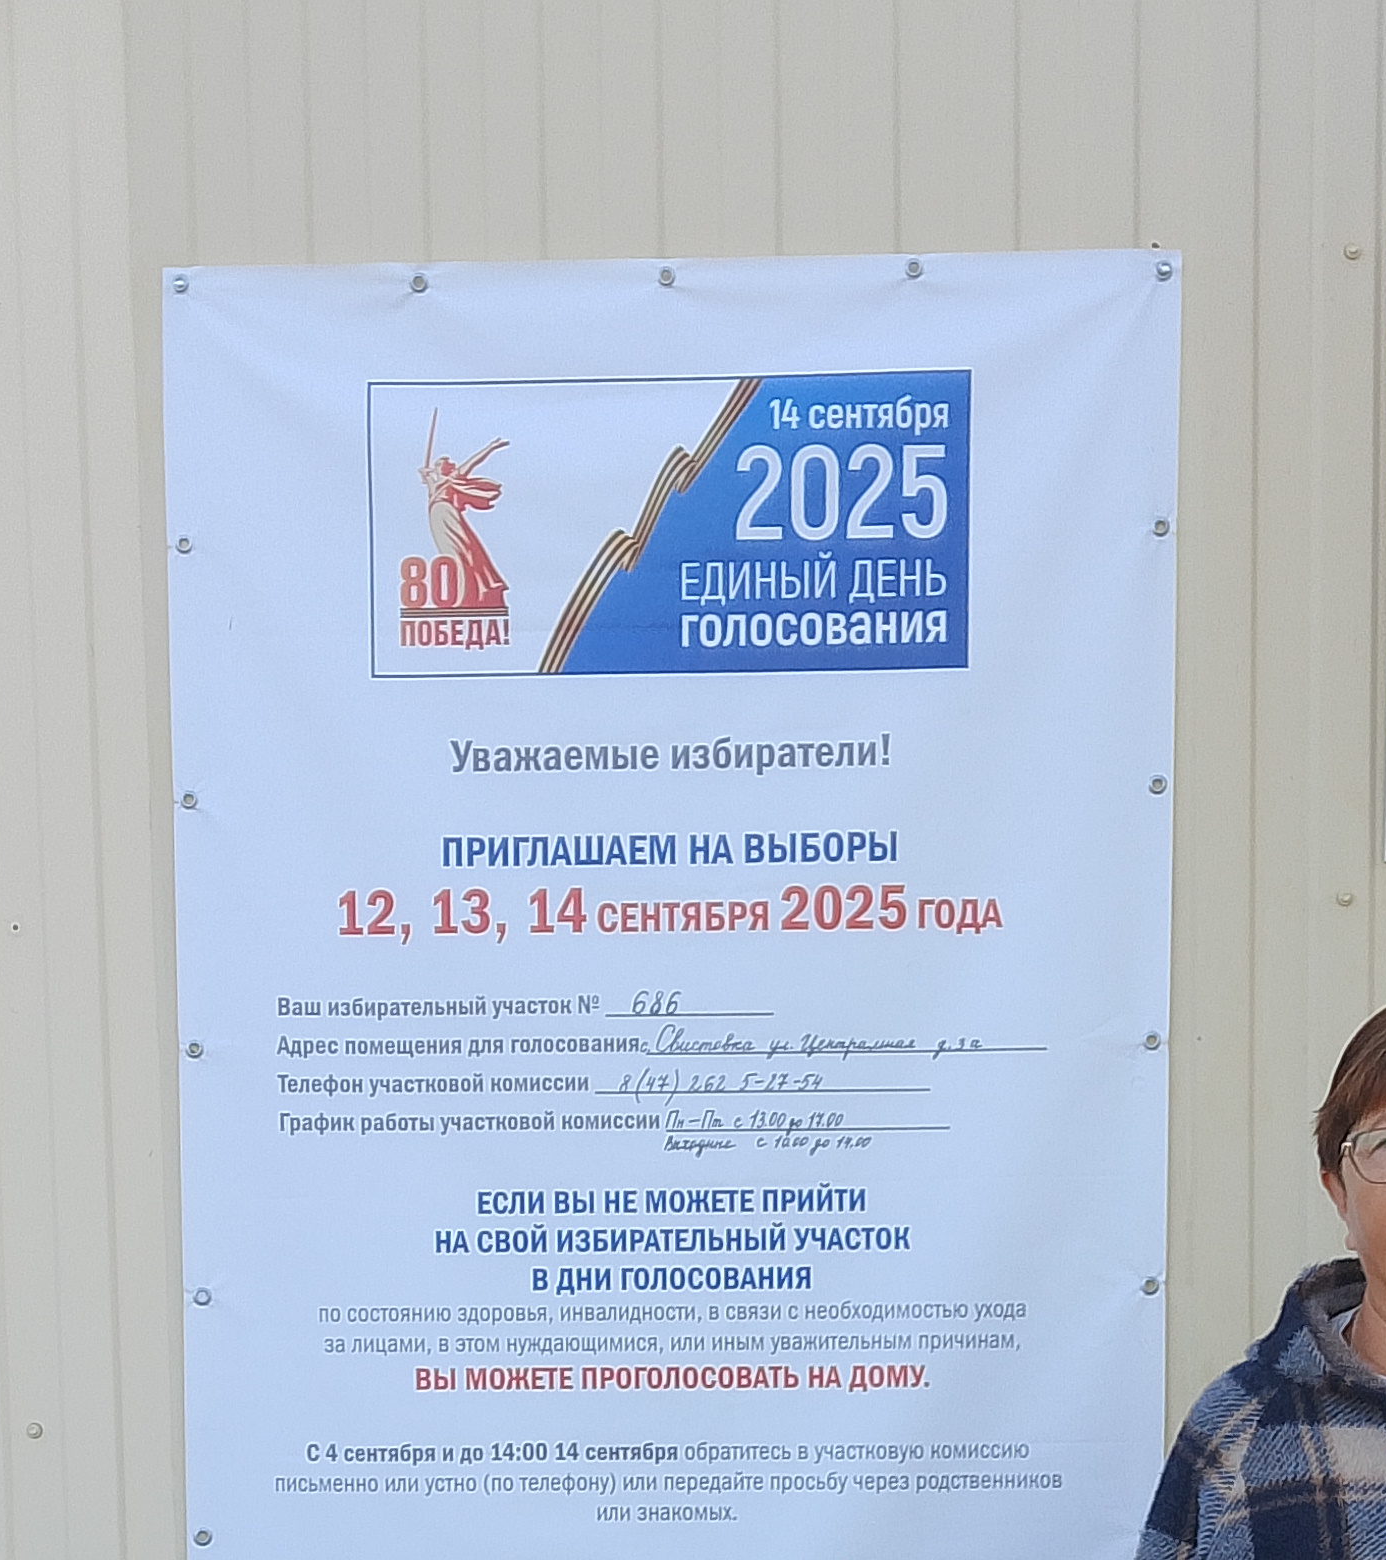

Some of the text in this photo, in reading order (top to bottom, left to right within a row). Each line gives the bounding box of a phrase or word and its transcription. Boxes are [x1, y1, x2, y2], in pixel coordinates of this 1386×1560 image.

[769, 394, 950, 436] 14 сентября
[735, 443, 948, 542] 2025
[399, 556, 459, 608] 80
[680, 551, 948, 606] ЕДИНЫЙ ДЕНЬ
[399, 619, 510, 650] ПОБЕДА!
[680, 609, 949, 648] голосования
[449, 733, 891, 776] Уважаемые избиратели!
[442, 830, 898, 868] ПРИГЛАШАЕМ НА ВЫБОРЫ
[338, 884, 1004, 946] 12, 13, 14 СЕНТЯБРЯ 2025 ГОДА
[277, 994, 600, 1021] Ваш избирательный участок №
[632, 990, 682, 1015] 686
[276, 1035, 640, 1060] Адрес помещения для голосования
[276, 1073, 589, 1098] Телефон участковой комиссии
[279, 1110, 660, 1137] График работы участковой комиссии
[477, 1182, 866, 1215] ЕСЛИ ВЫ НЕ МОЖЕТЕ ПРИЙТИ
[435, 1222, 911, 1254] НА СВОЙ ИЗБИРАТЕЛЬНЫЙ УЧАСТОК
[532, 1266, 812, 1296] В ДНИ ГОЛОСОВАНИЯ
[318, 1299, 1027, 1327] по состоянию здоровья, инвалидности, в связи с необходимостью ухода
[323, 1332, 1021, 1357] за лицами, в этом нуждающимися, или иным уважительным причинам,
[415, 1364, 931, 1393] ВЫ МОЖЕТЕ ПРОГОЛОСОВАТЬ НА ДОМУ.
[306, 1441, 1030, 1467] С 4 сентября и до 14:00 14 сентября обратитесь в участковую комиссию
[275, 1470, 1063, 1497] письменно или устно (по телефону) или передайте просьбу через родственников
[596, 1505, 738, 1522] или знакомых.
